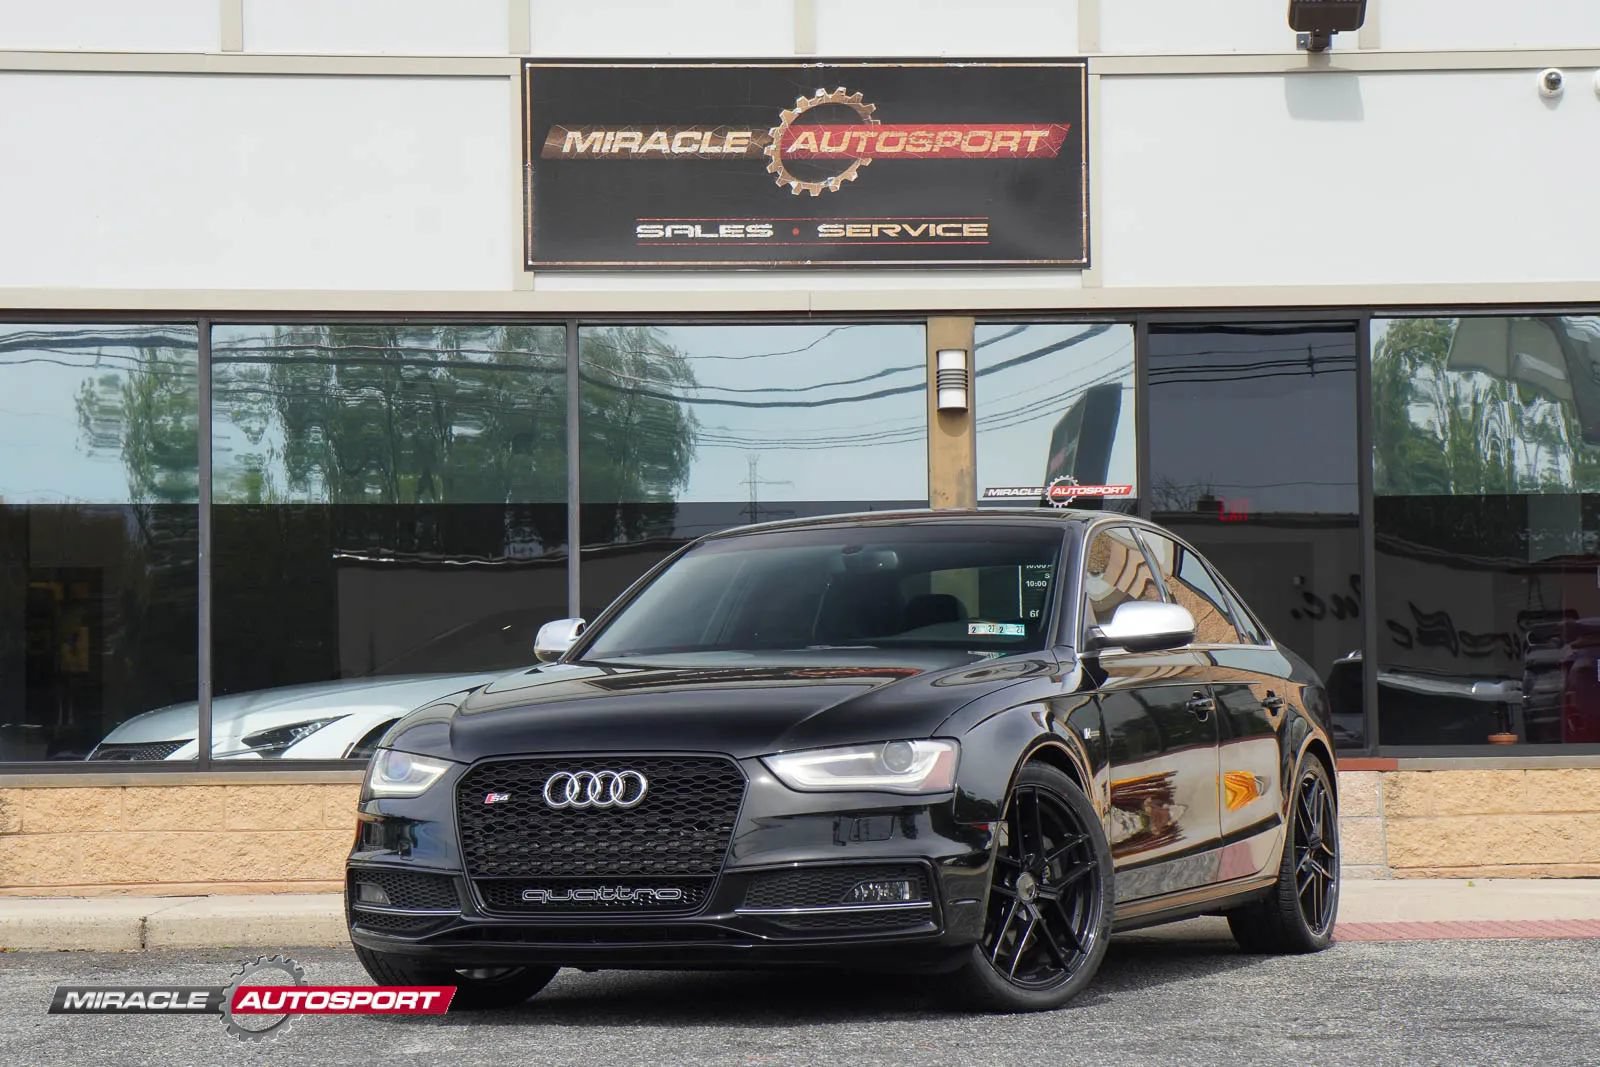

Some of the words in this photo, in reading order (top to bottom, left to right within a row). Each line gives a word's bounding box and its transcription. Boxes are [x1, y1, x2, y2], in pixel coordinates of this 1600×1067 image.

[561, 131, 753, 154] MIRACLE
[786, 130, 1051, 154] AUTOSPORT
[636, 223, 774, 239] SALES
[817, 222, 989, 238] SERVICE
[987, 488, 1043, 496] MIRACLE
[1051, 486, 1128, 495] AUTOSPORT
[521, 885, 682, 903] quattro
